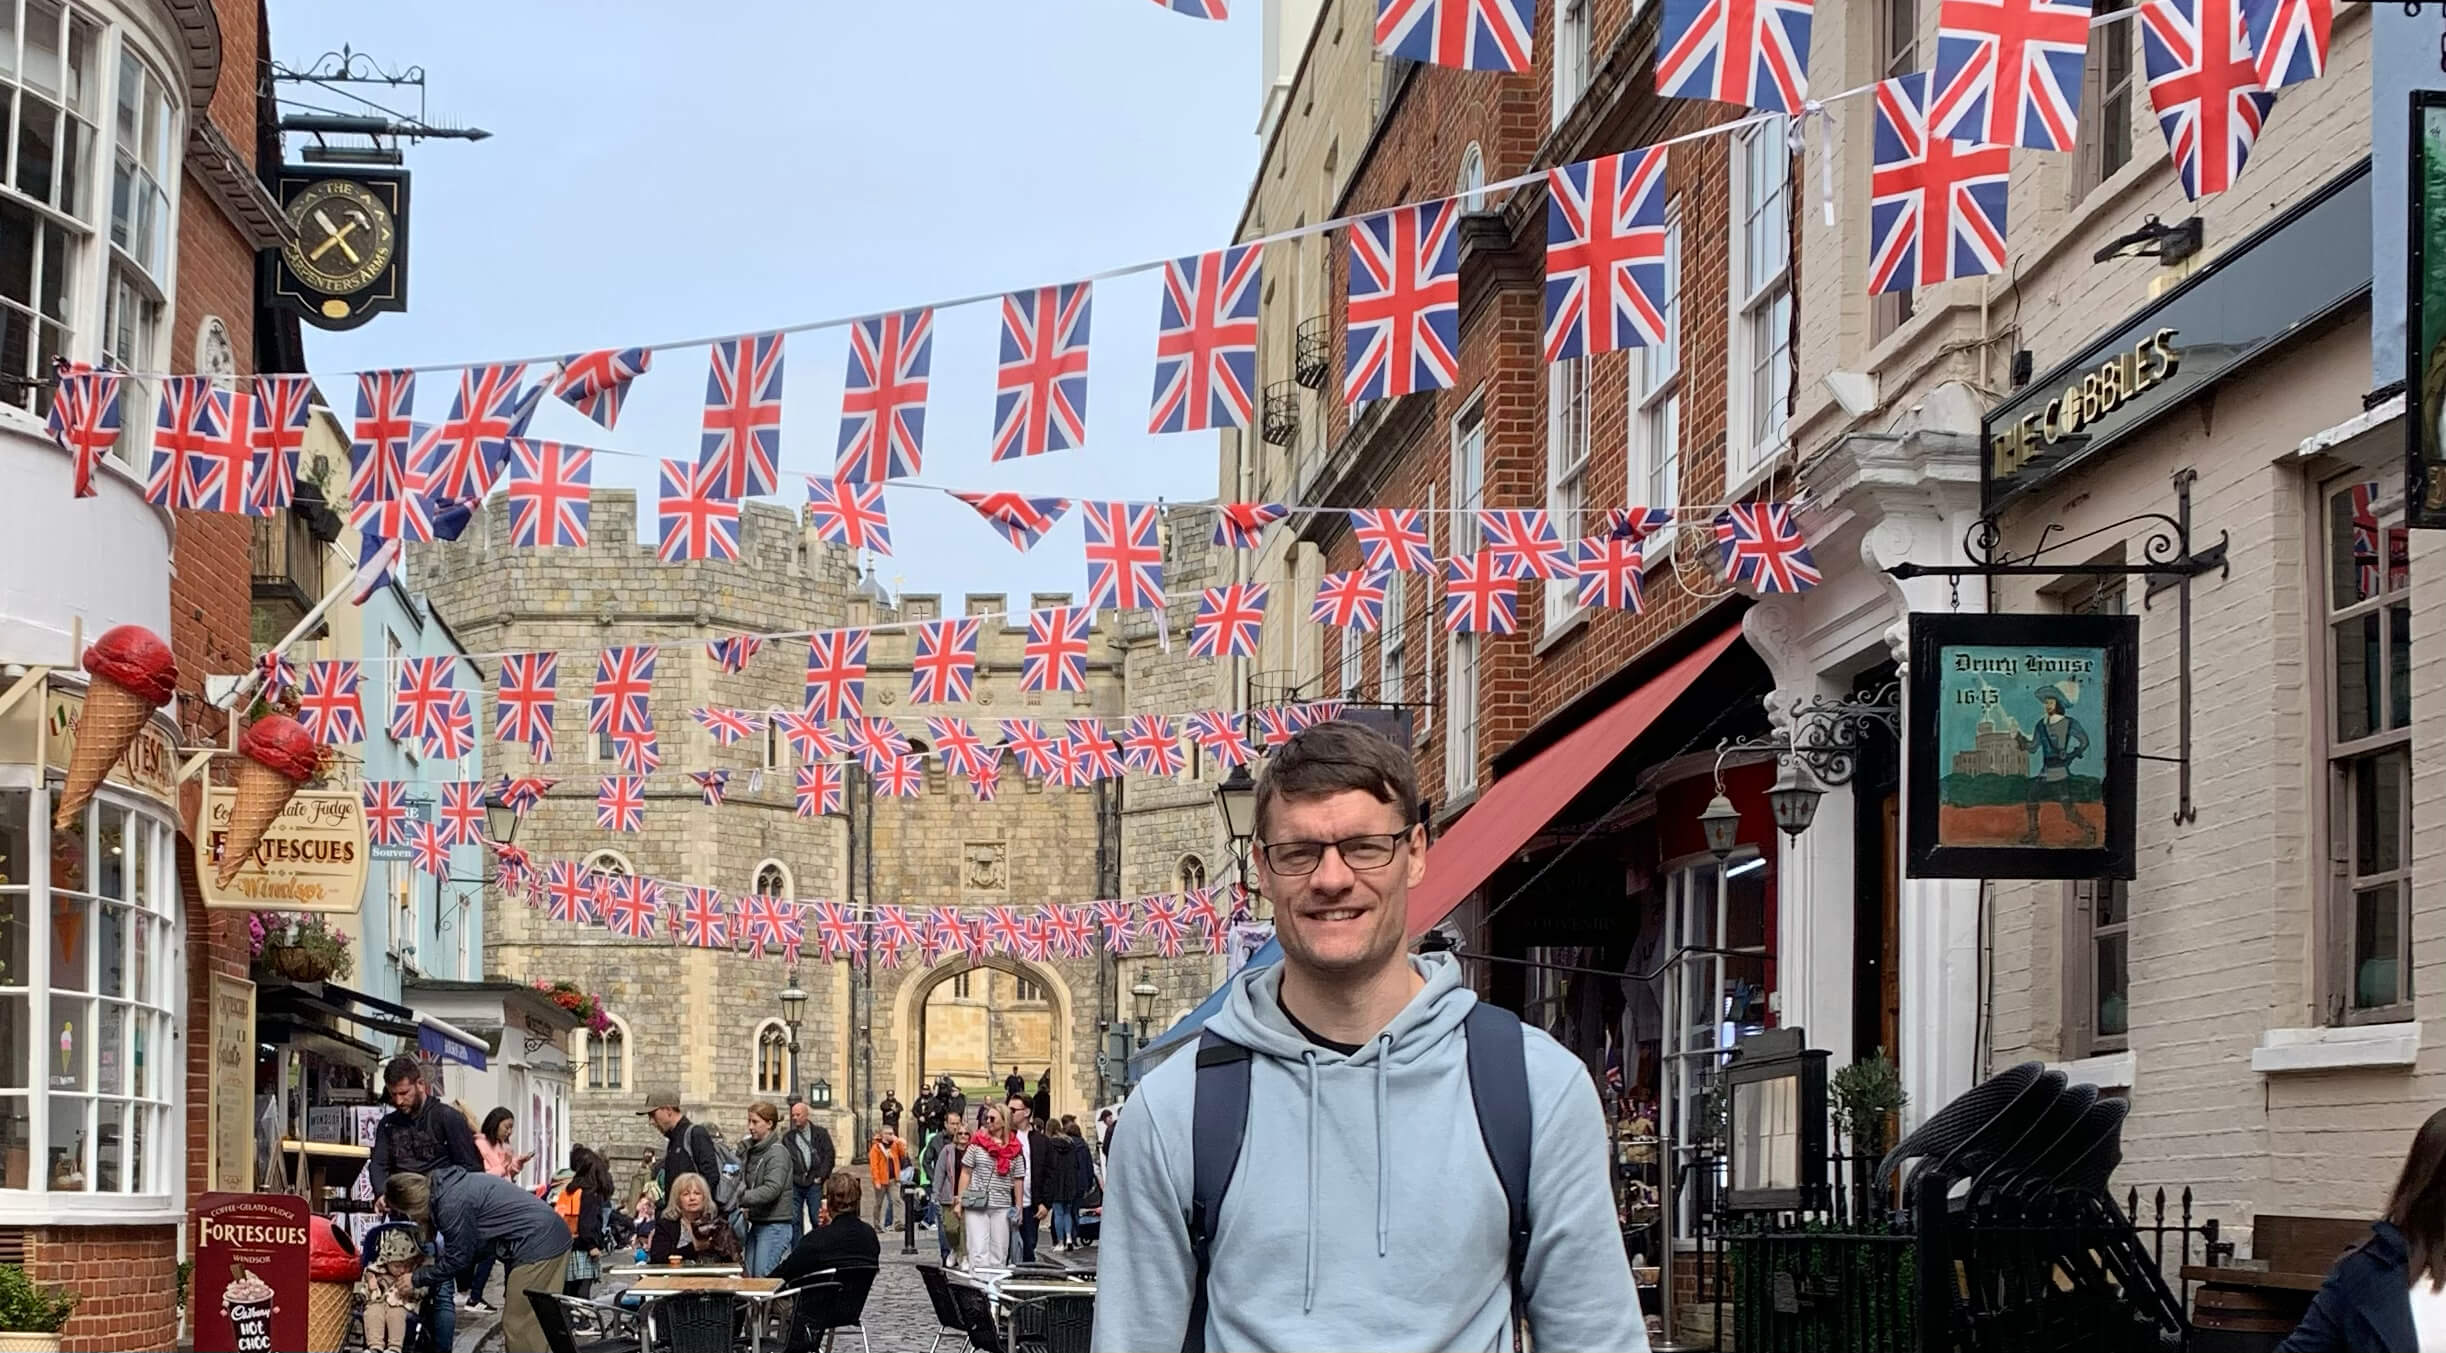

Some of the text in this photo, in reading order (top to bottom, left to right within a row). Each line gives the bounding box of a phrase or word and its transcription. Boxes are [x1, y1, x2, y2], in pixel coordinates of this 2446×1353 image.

[325, 183, 354, 195] THE
[284, 247, 389, 290] CARPENTERS ARMS
[1991, 328, 2179, 479] THE COBBLES
[1955, 653, 2094, 677] Drury House
[307, 800, 353, 827] Fudge
[208, 831, 355, 869] FRTESCUES
[372, 846, 412, 858] Souven
[239, 876, 326, 904] Windsor
[199, 1216, 307, 1248] FORTESCUES
[233, 1254, 271, 1264] WINDSOR
[231, 1305, 271, 1321] Cadbury
[238, 1336, 270, 1351] CHOC
